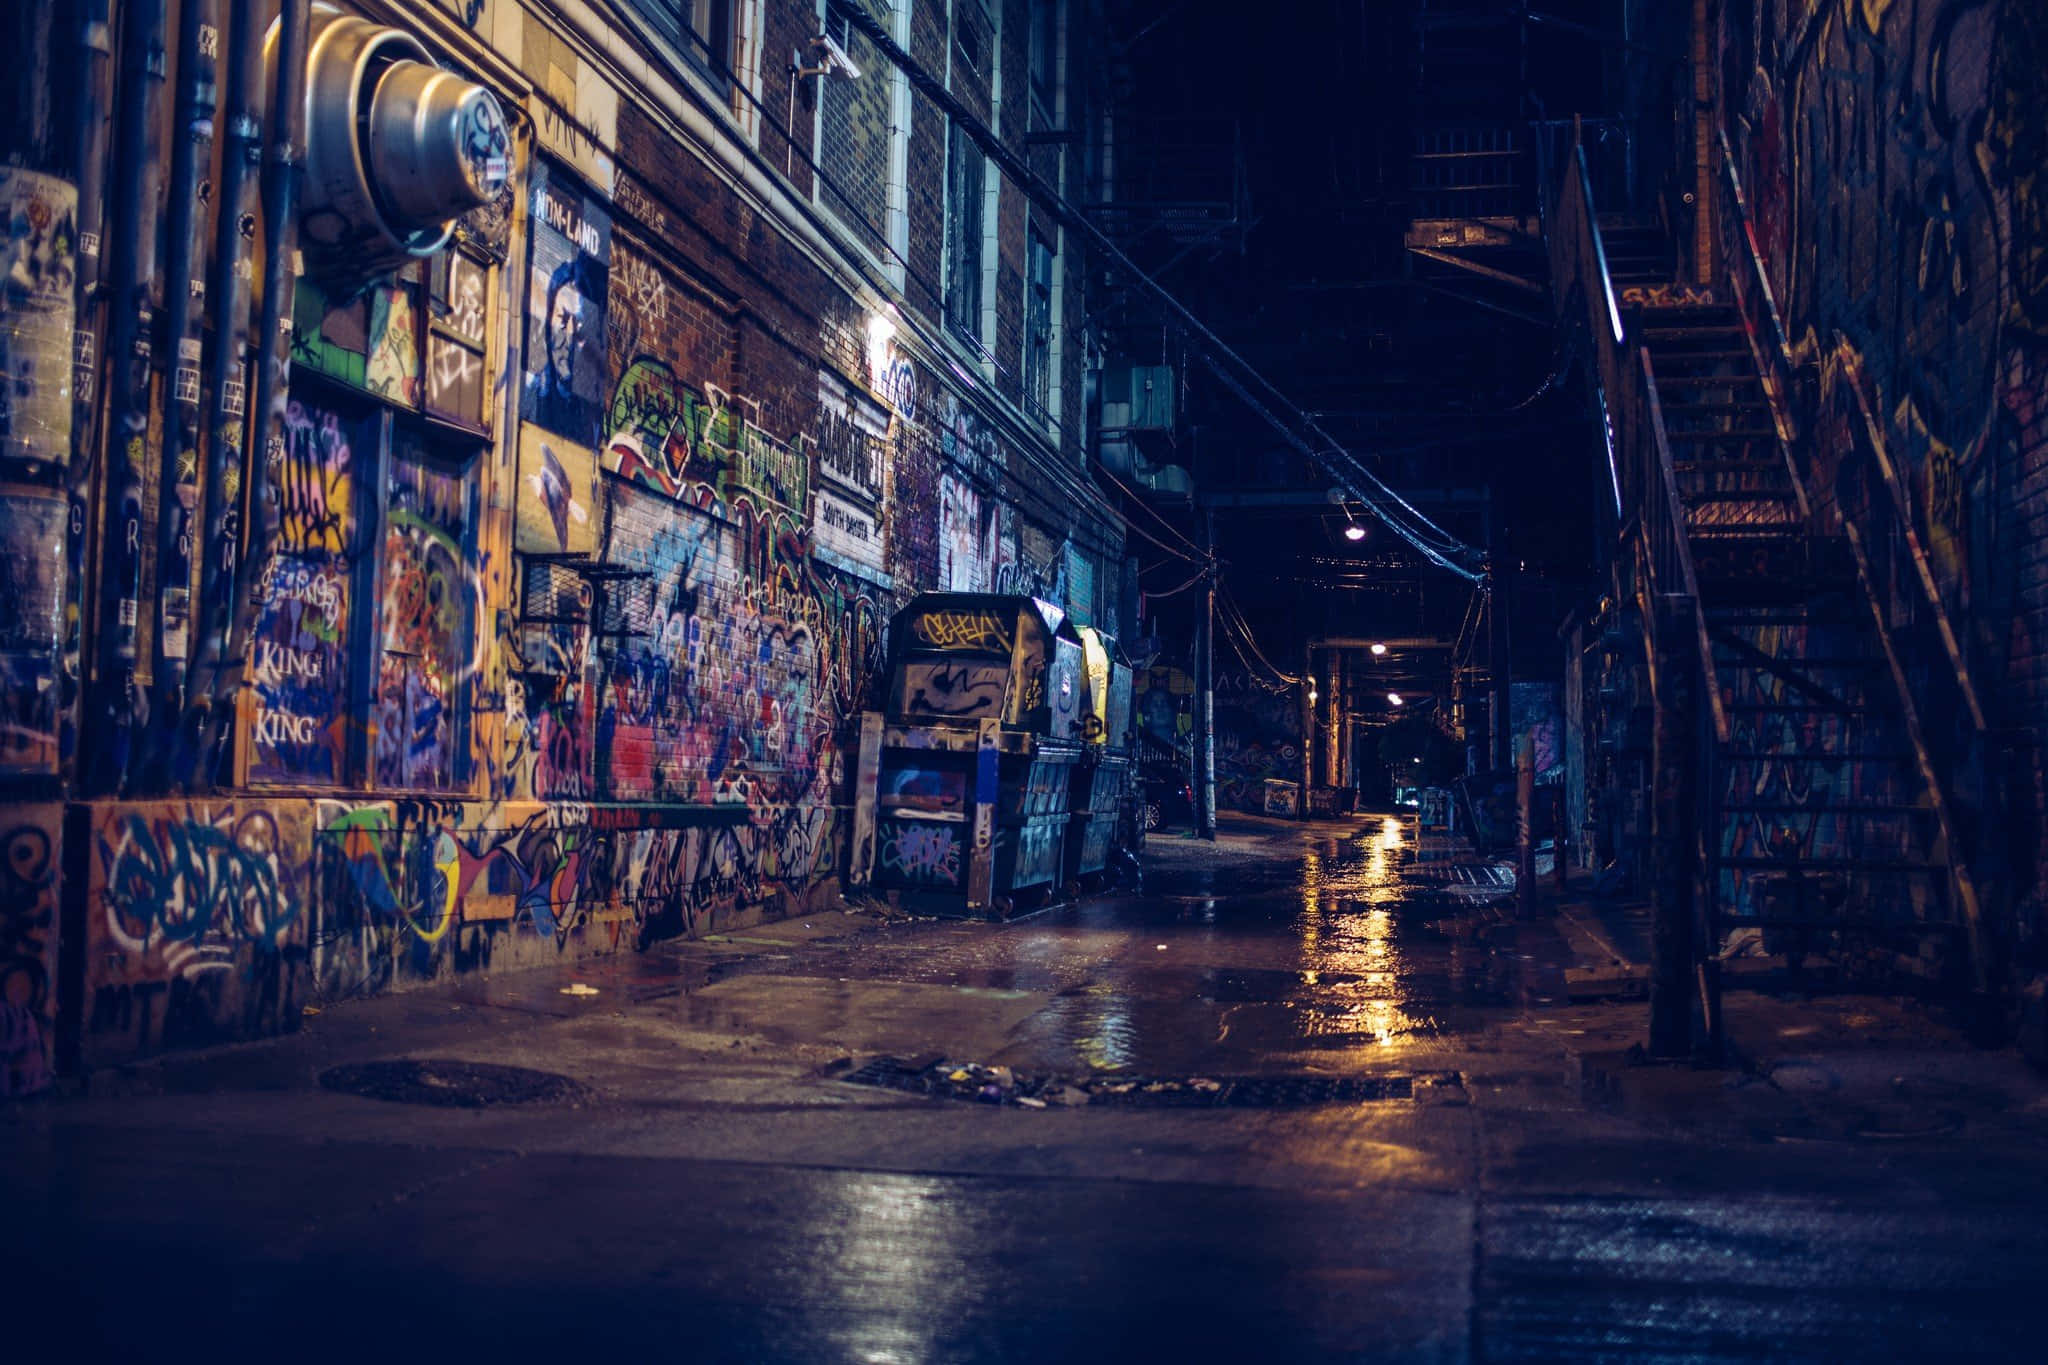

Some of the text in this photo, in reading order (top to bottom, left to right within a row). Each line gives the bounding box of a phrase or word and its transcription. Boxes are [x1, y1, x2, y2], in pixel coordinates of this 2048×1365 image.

[535, 188, 600, 257] NON-LAND
[823, 501, 868, 541] SOUTH DAKOTA
[262, 640, 319, 681] KING
[254, 707, 313, 748] KING
